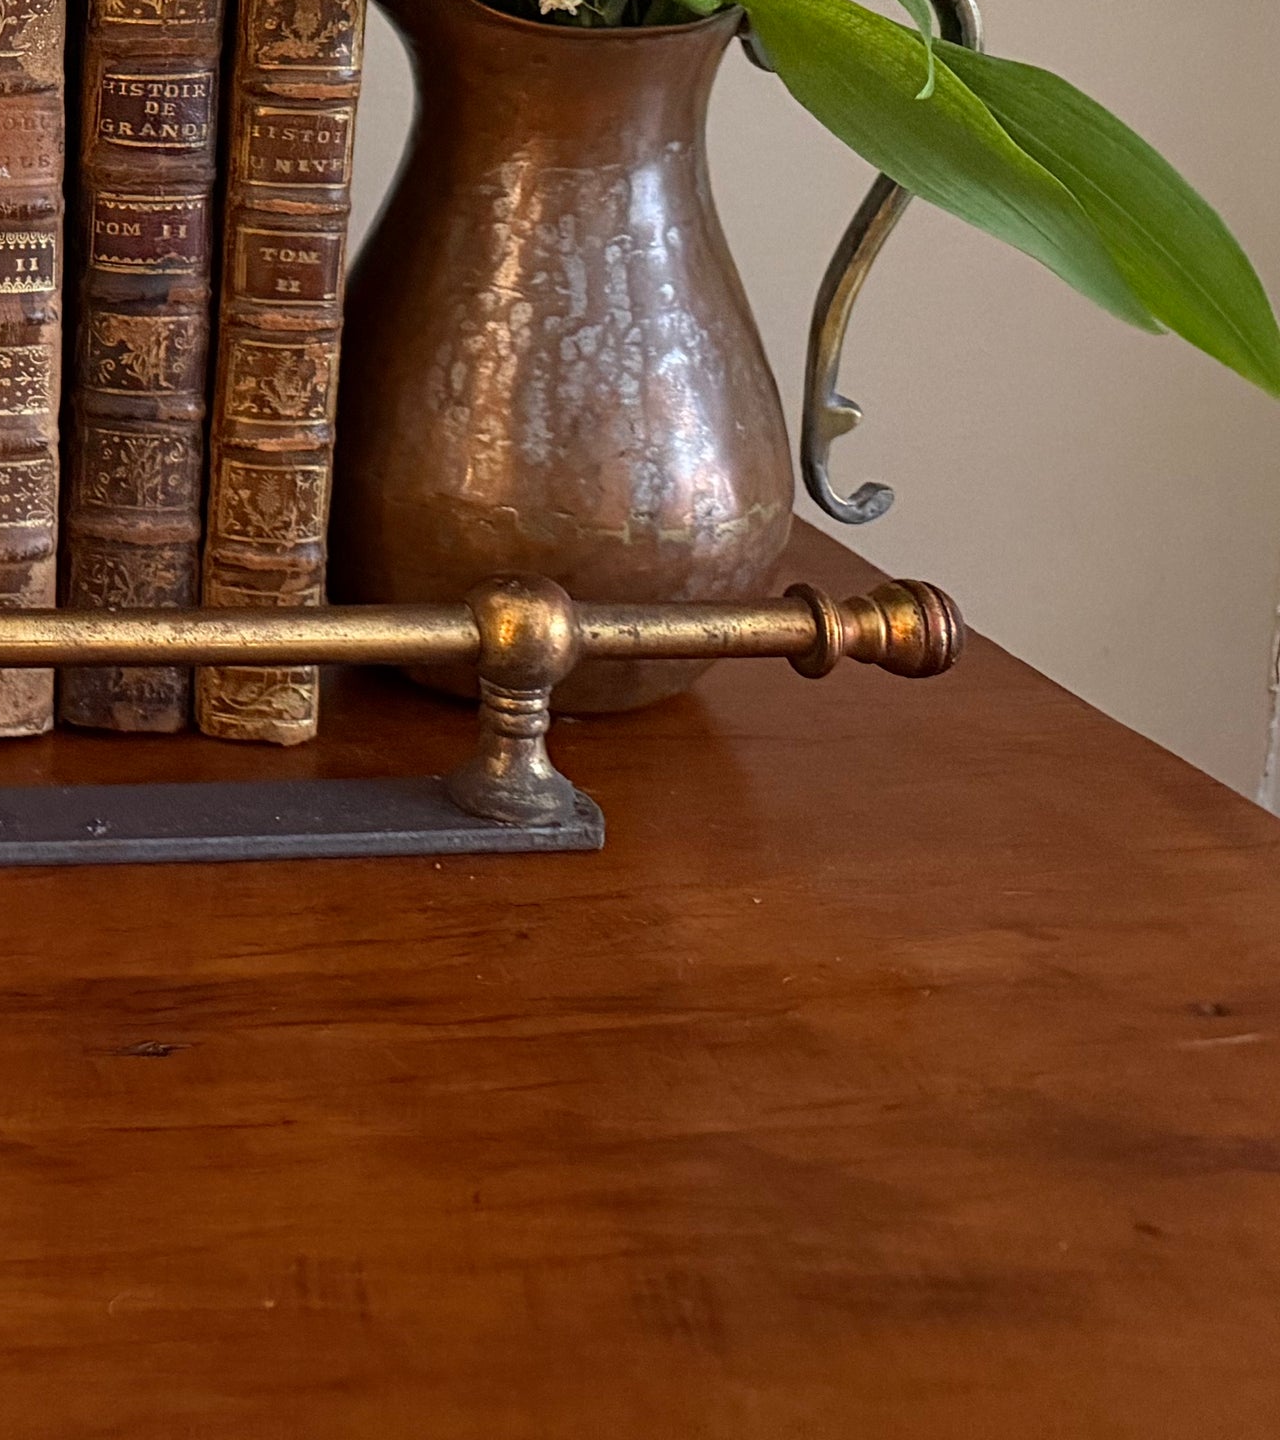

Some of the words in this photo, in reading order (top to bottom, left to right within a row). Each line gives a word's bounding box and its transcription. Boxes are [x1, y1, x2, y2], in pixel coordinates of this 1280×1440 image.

[144, 101, 176, 116] DE
[94, 220, 141, 236] TOM
[260, 247, 321, 264] TOM
[16, 257, 39, 272] II
